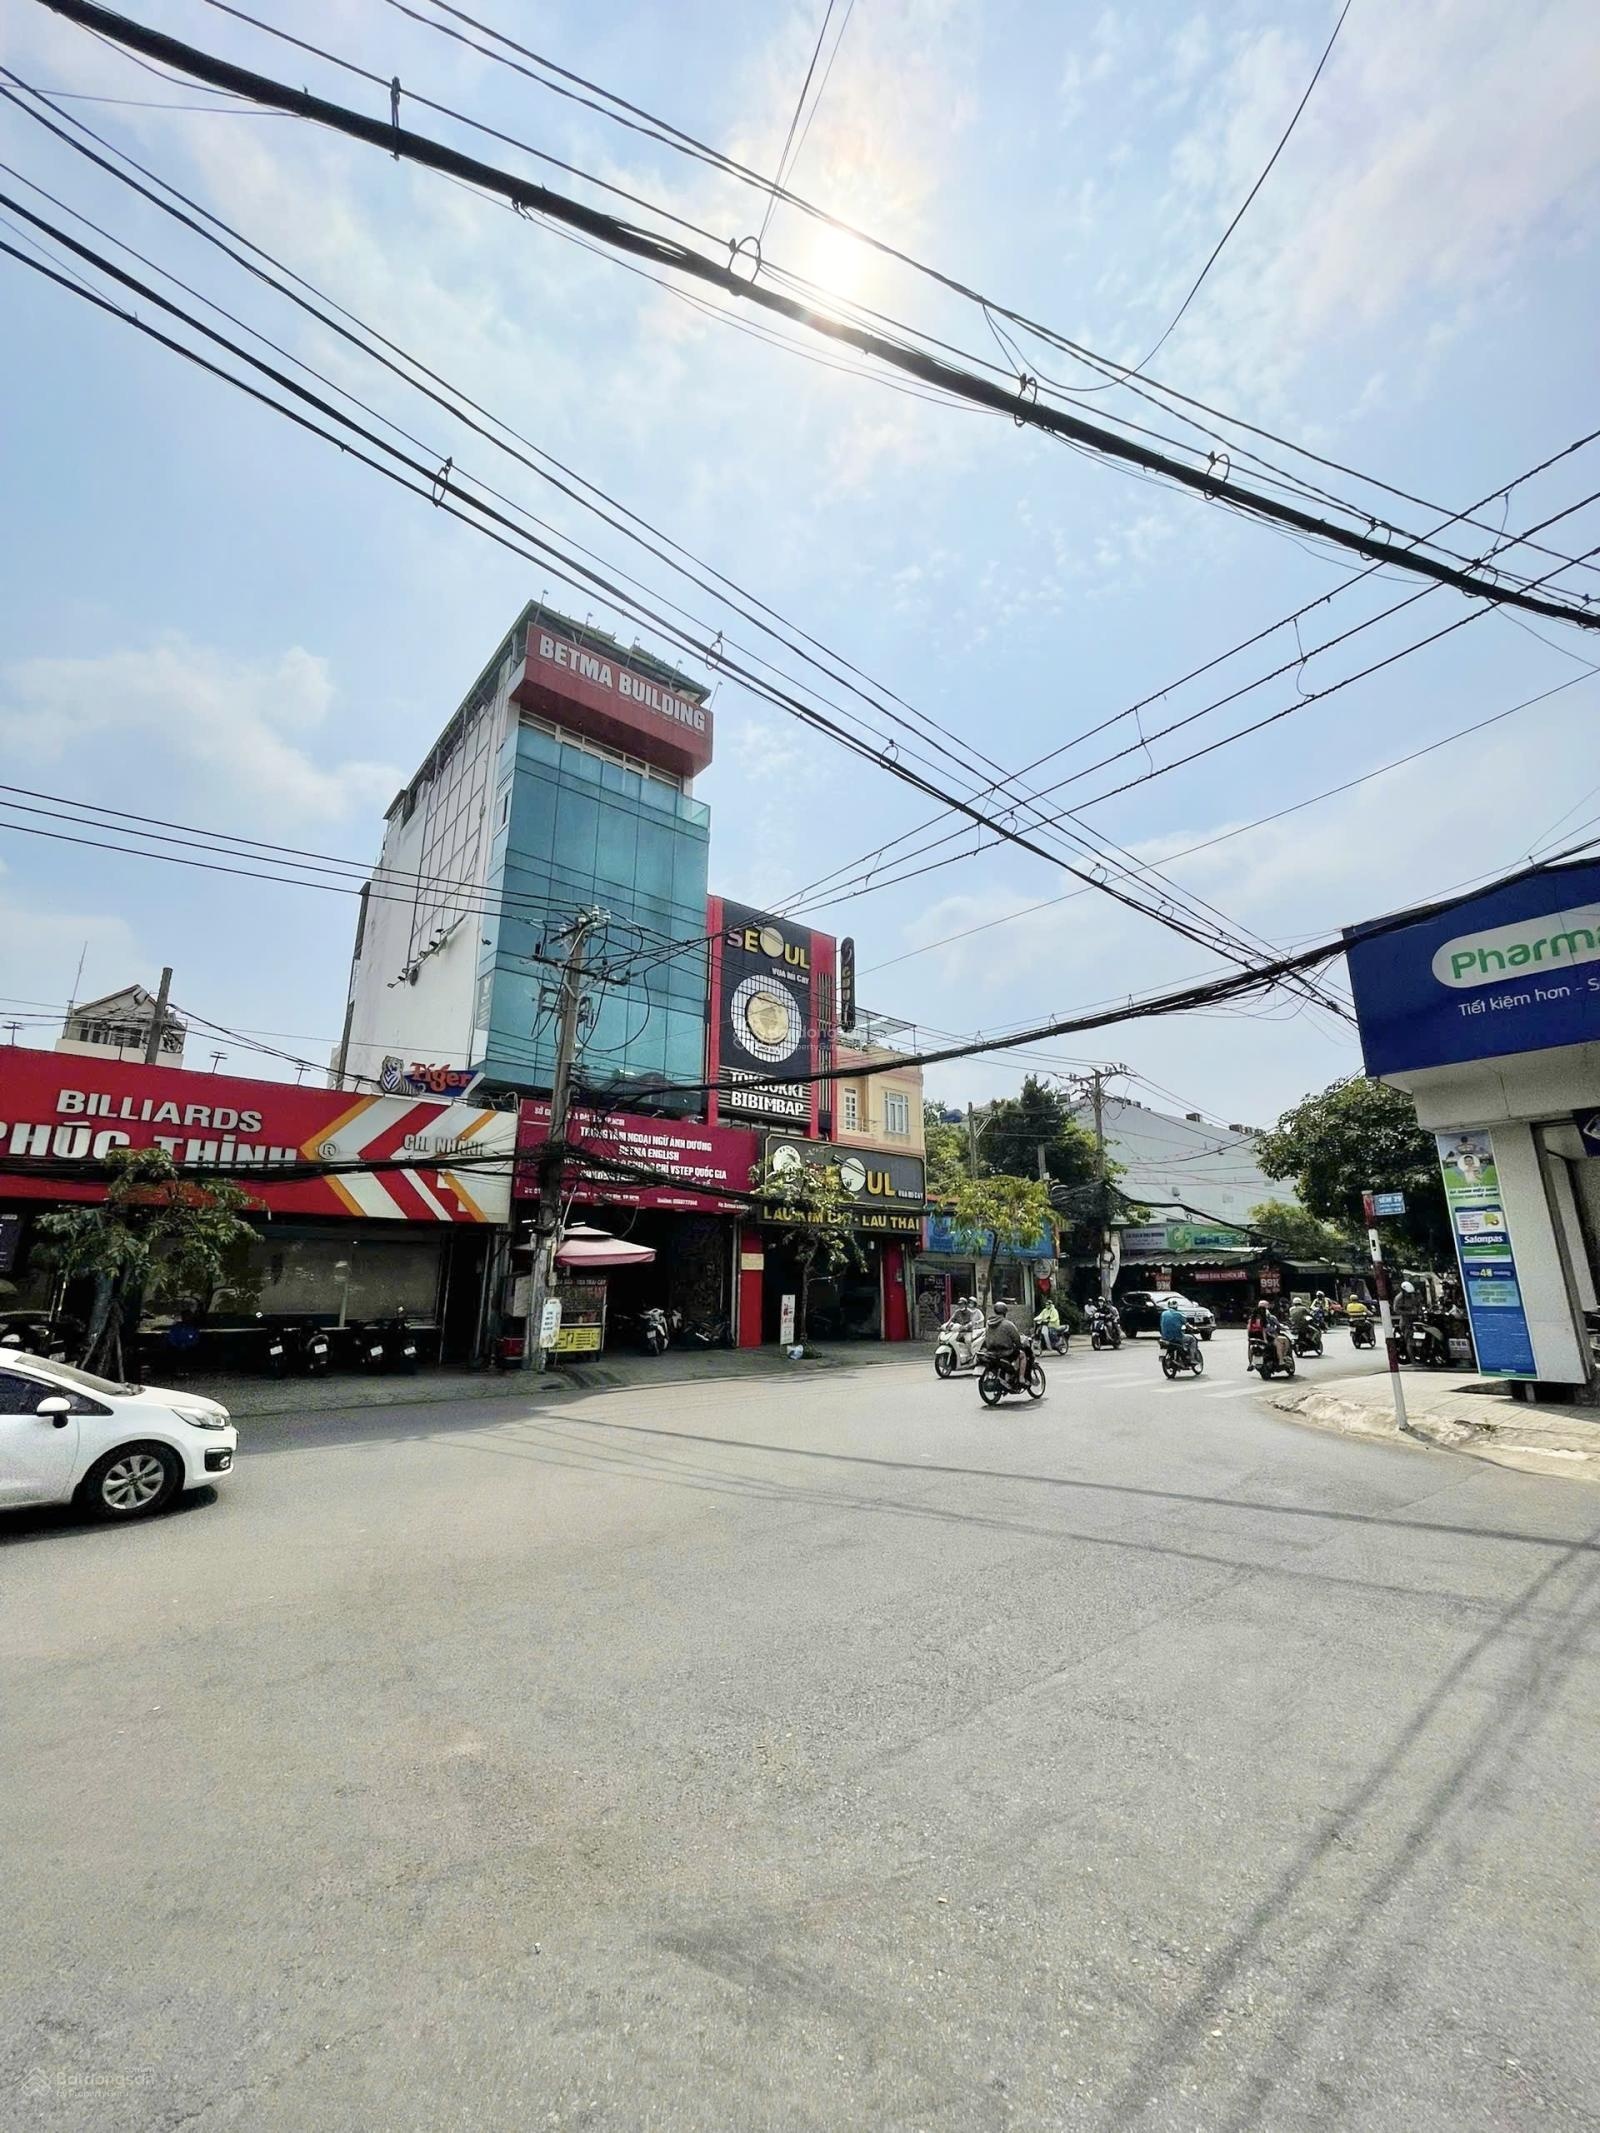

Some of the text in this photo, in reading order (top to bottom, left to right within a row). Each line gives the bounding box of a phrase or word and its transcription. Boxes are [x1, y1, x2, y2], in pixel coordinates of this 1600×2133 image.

[539, 633, 706, 733] BETMA BUILDING
[1450, 928, 1600, 980] Pharm
[1458, 1000, 1486, 1017] Tiết
[1491, 991, 1531, 1012] kiệm
[1535, 985, 1570, 1002] hơn
[410, 1061, 477, 1092] Tiger
[56, 1088, 262, 1133] BILLIARDS
[731, 1091, 804, 1116] BIBIMBAP
[648, 1148, 680, 1161] ENGLISH
[670, 1165, 694, 1176] VSTEP
[714, 1169, 727, 1180] GIA
[1464, 1235, 1504, 1244] Salonpas
